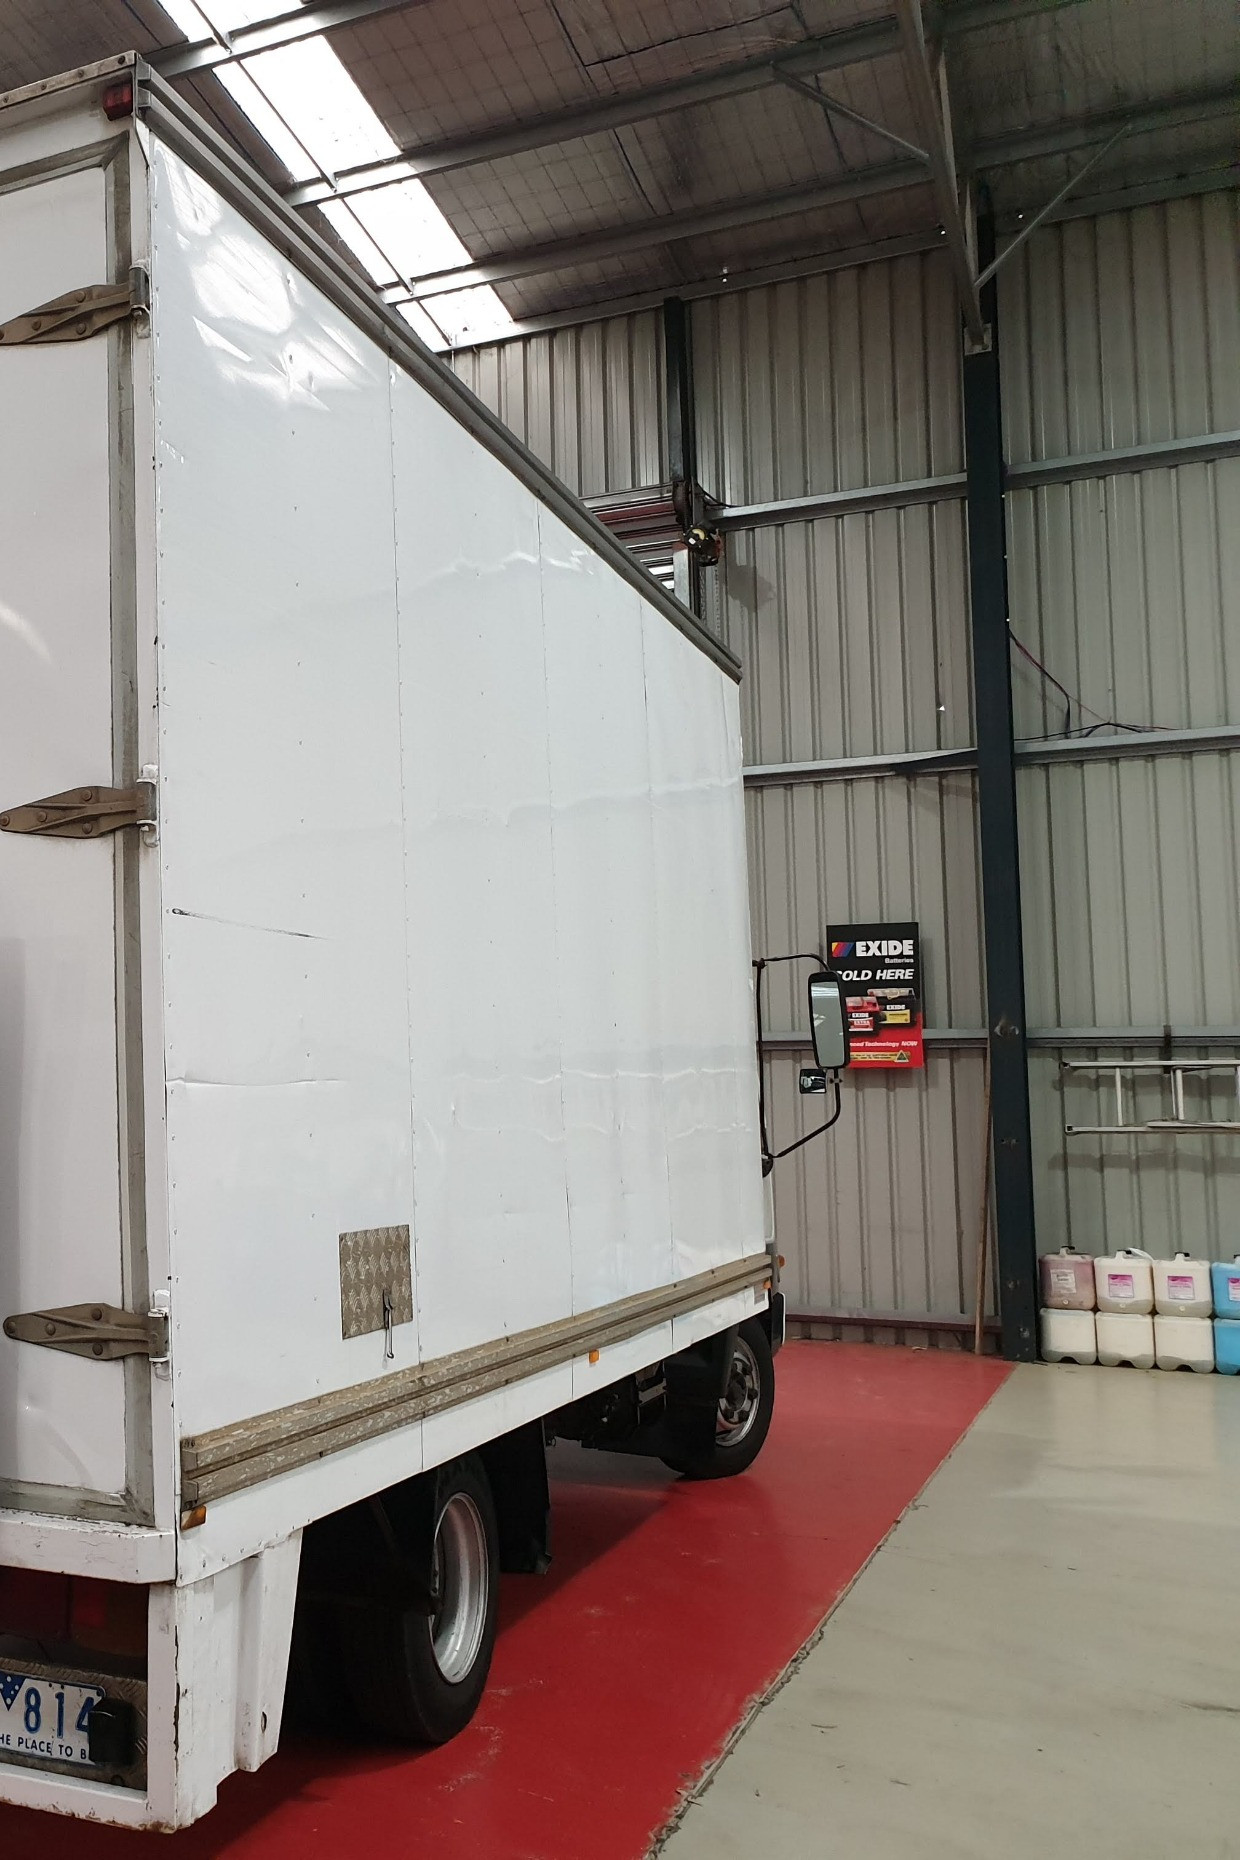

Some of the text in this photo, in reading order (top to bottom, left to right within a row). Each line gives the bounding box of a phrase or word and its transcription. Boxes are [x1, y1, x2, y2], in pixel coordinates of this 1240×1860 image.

[856, 940, 914, 957] EXIDE
[837, 969, 914, 981] OLD HERE
[23, 1686, 95, 1739] 814
[17, 1737, 53, 1755] PLACE
[59, 1744, 73, 1758] TO
[80, 1748, 90, 1760] B
